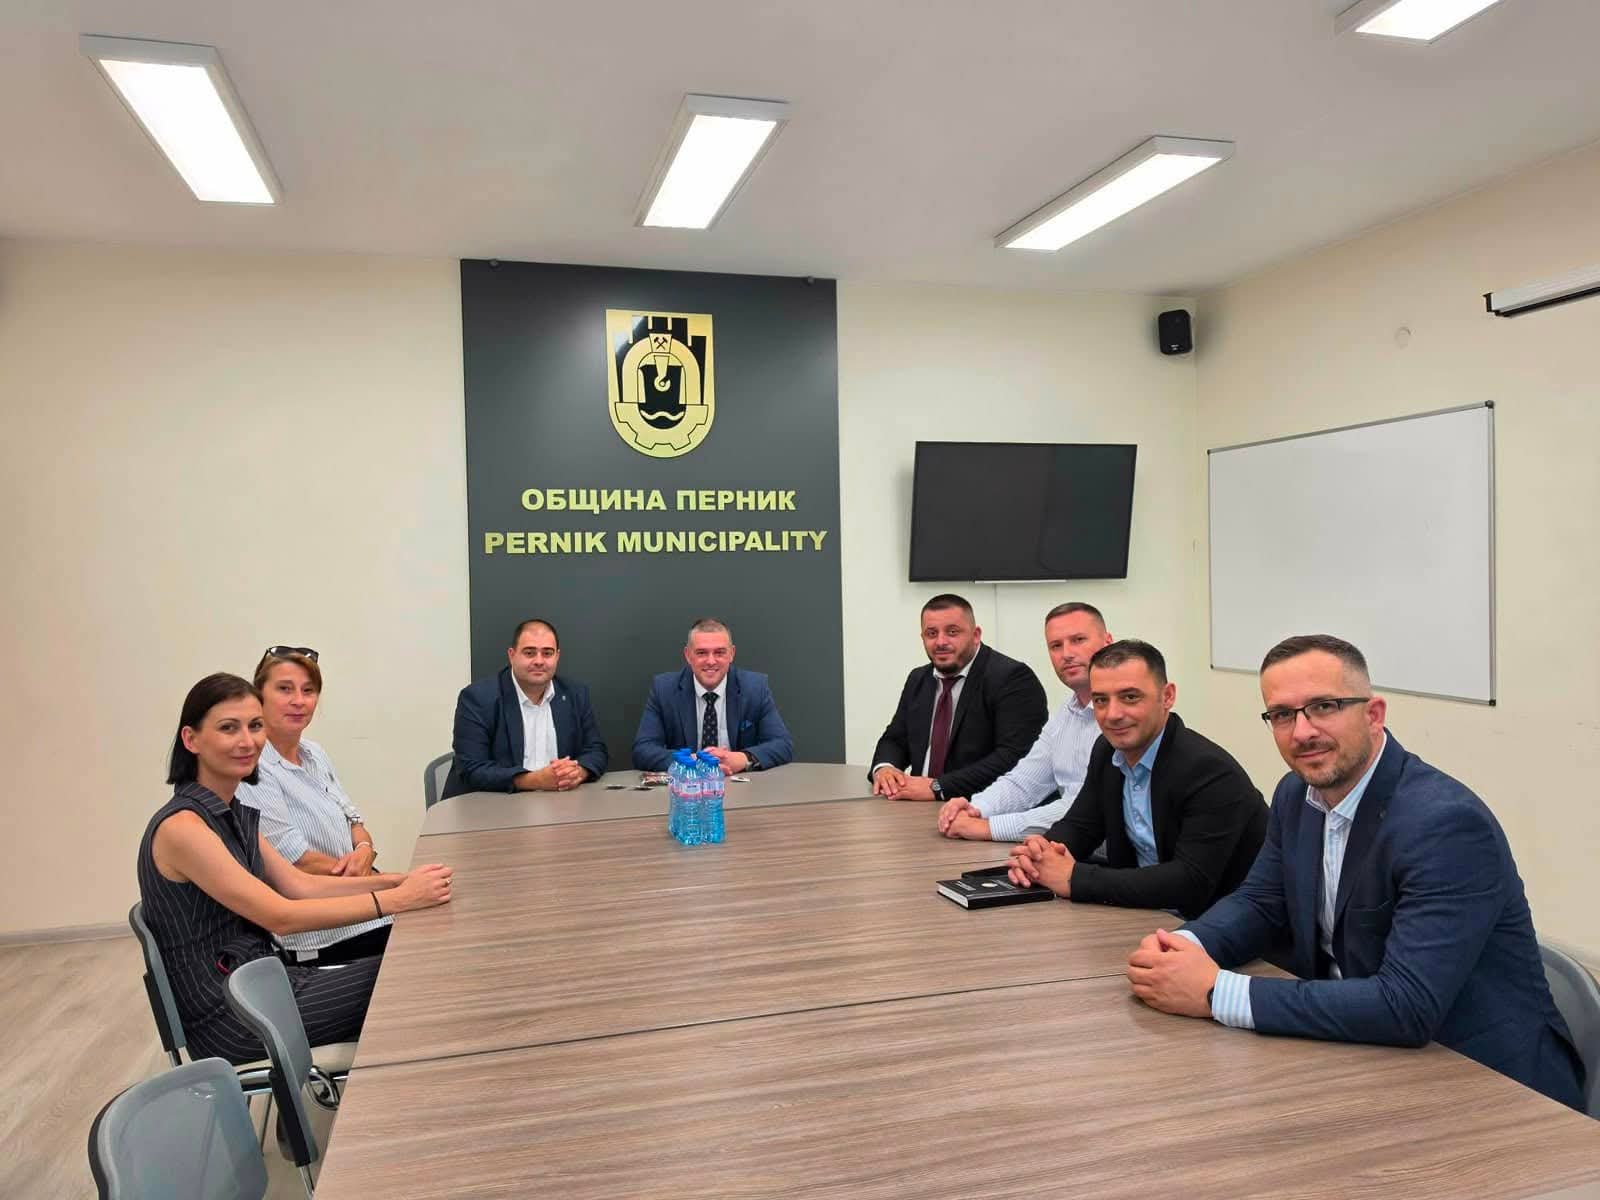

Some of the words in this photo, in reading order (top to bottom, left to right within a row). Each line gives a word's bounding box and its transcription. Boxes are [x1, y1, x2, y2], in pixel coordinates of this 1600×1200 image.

[521, 488, 667, 514] ОБЩИНА
[676, 489, 796, 511] ПЕРНИК
[484, 531, 607, 554] PERNIK
[617, 530, 827, 553] MUNICIPALITY
